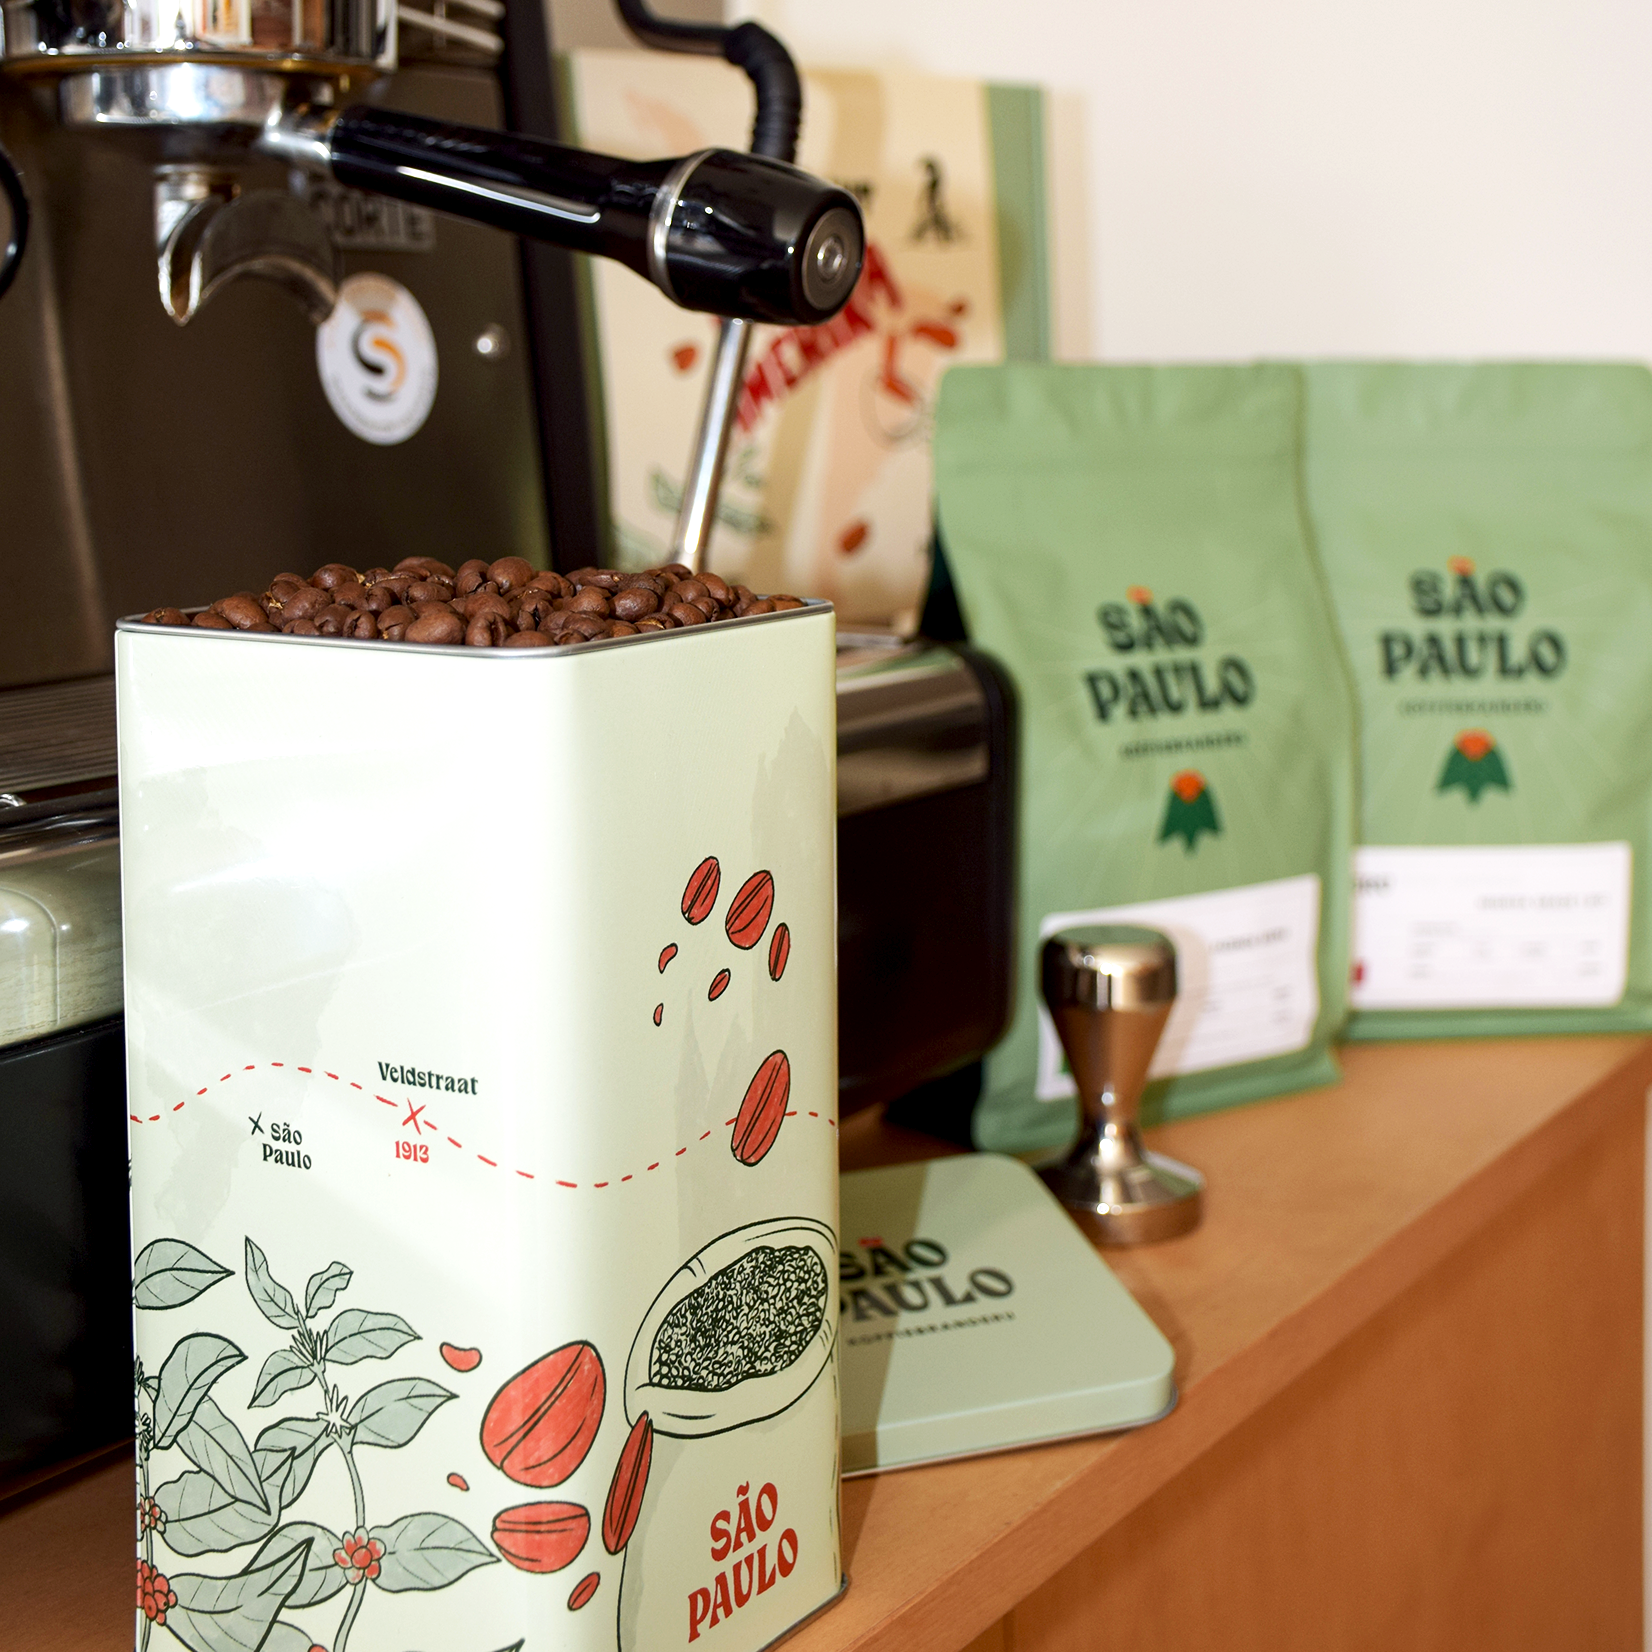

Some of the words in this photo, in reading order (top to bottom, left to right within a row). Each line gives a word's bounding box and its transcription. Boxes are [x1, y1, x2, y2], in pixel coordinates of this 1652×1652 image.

[1379, 628, 1567, 682] PAULO
[1085, 655, 1256, 722] PAULO
[377, 1061, 479, 1096] Veldstraat
[262, 1143, 312, 1170] Paulo
[270, 1122, 303, 1146] São
[394, 1140, 430, 1164] 1913
[839, 1267, 1014, 1320] AULO
[710, 1481, 778, 1562] SÃO
[687, 1527, 799, 1643] PAULO
